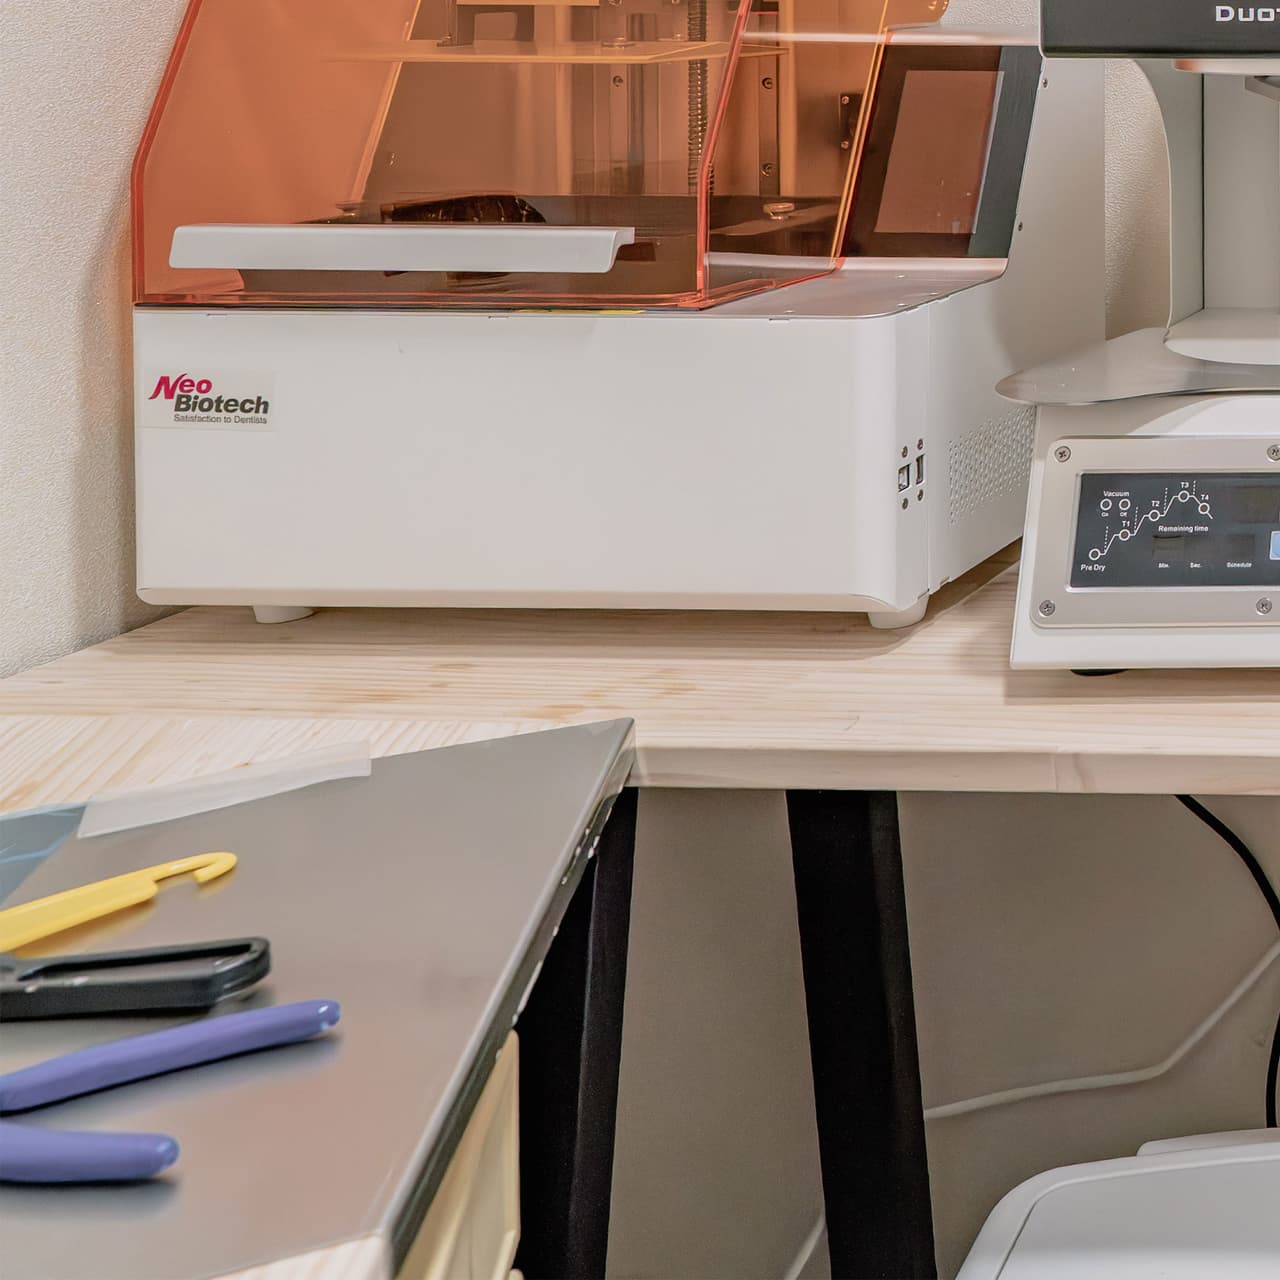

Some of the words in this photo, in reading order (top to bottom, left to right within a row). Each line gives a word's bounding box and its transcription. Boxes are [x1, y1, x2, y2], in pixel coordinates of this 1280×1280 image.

[148, 373, 213, 400] Neo
[173, 394, 270, 415] Biotech
[173, 413, 222, 424] Satisfaction
[223, 415, 232, 424] to
[234, 415, 268, 425] Dentists
[1158, 525, 1194, 533] Remaining
[1094, 564, 1106, 572] Dry
